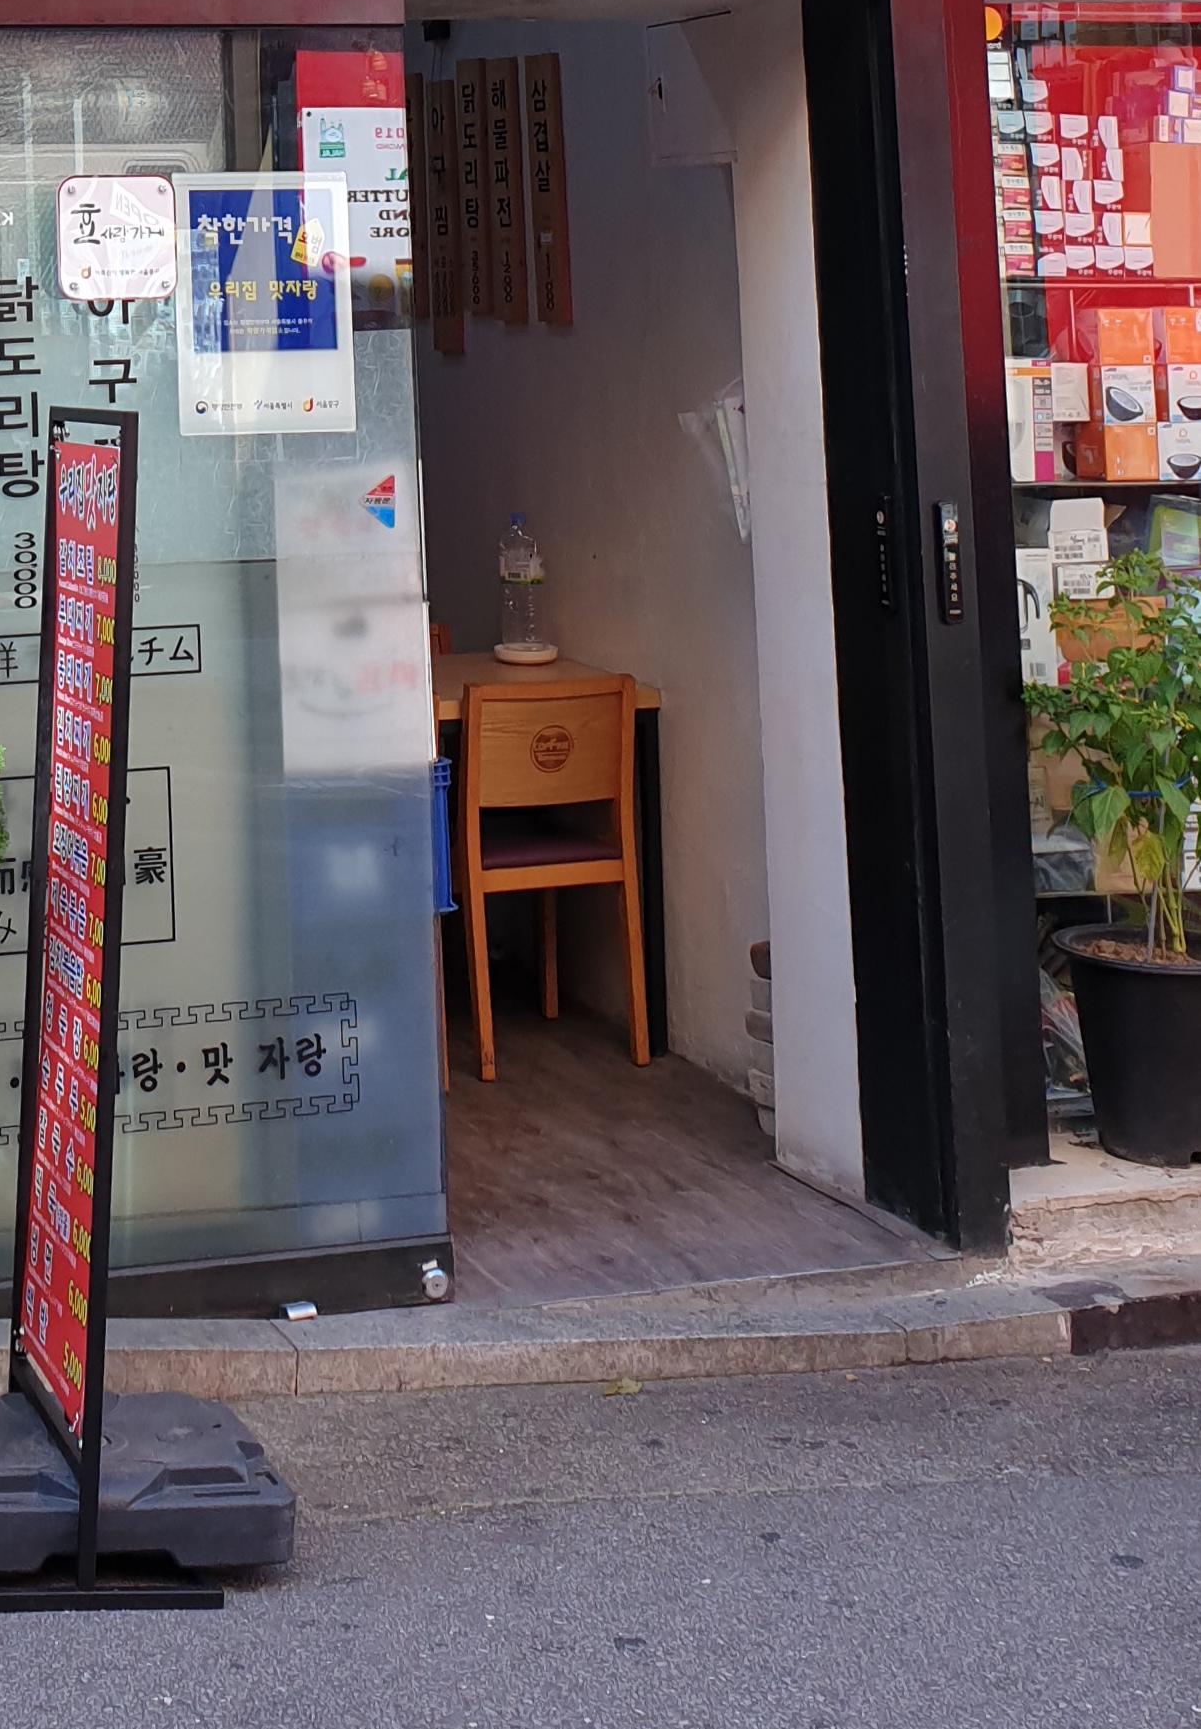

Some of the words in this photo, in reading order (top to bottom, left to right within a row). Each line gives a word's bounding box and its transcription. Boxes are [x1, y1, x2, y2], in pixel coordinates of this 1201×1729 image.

[461, 82, 480, 229] 닭도리탕
[490, 79, 512, 228] 해물파전
[530, 78, 552, 193] 삼겹살
[197, 214, 293, 247] 착한가격
[208, 280, 257, 301] 우리집
[268, 280, 319, 301] 맛자랑
[56, 705, 92, 762] 김치찌개
[54, 762, 90, 822] 된장찌개
[52, 819, 89, 880] 오징어볶음
[50, 876, 87, 940] 제육볶음
[48, 933, 85, 1001] 김치볶음밥
[45, 988, 83, 1061] 청국장
[41, 1047, 79, 1121] 순두부
[38, 1104, 75, 1182] 칼국수
[68, 1279, 88, 1328] 6,000
[62, 1340, 83, 1391] 5,000
